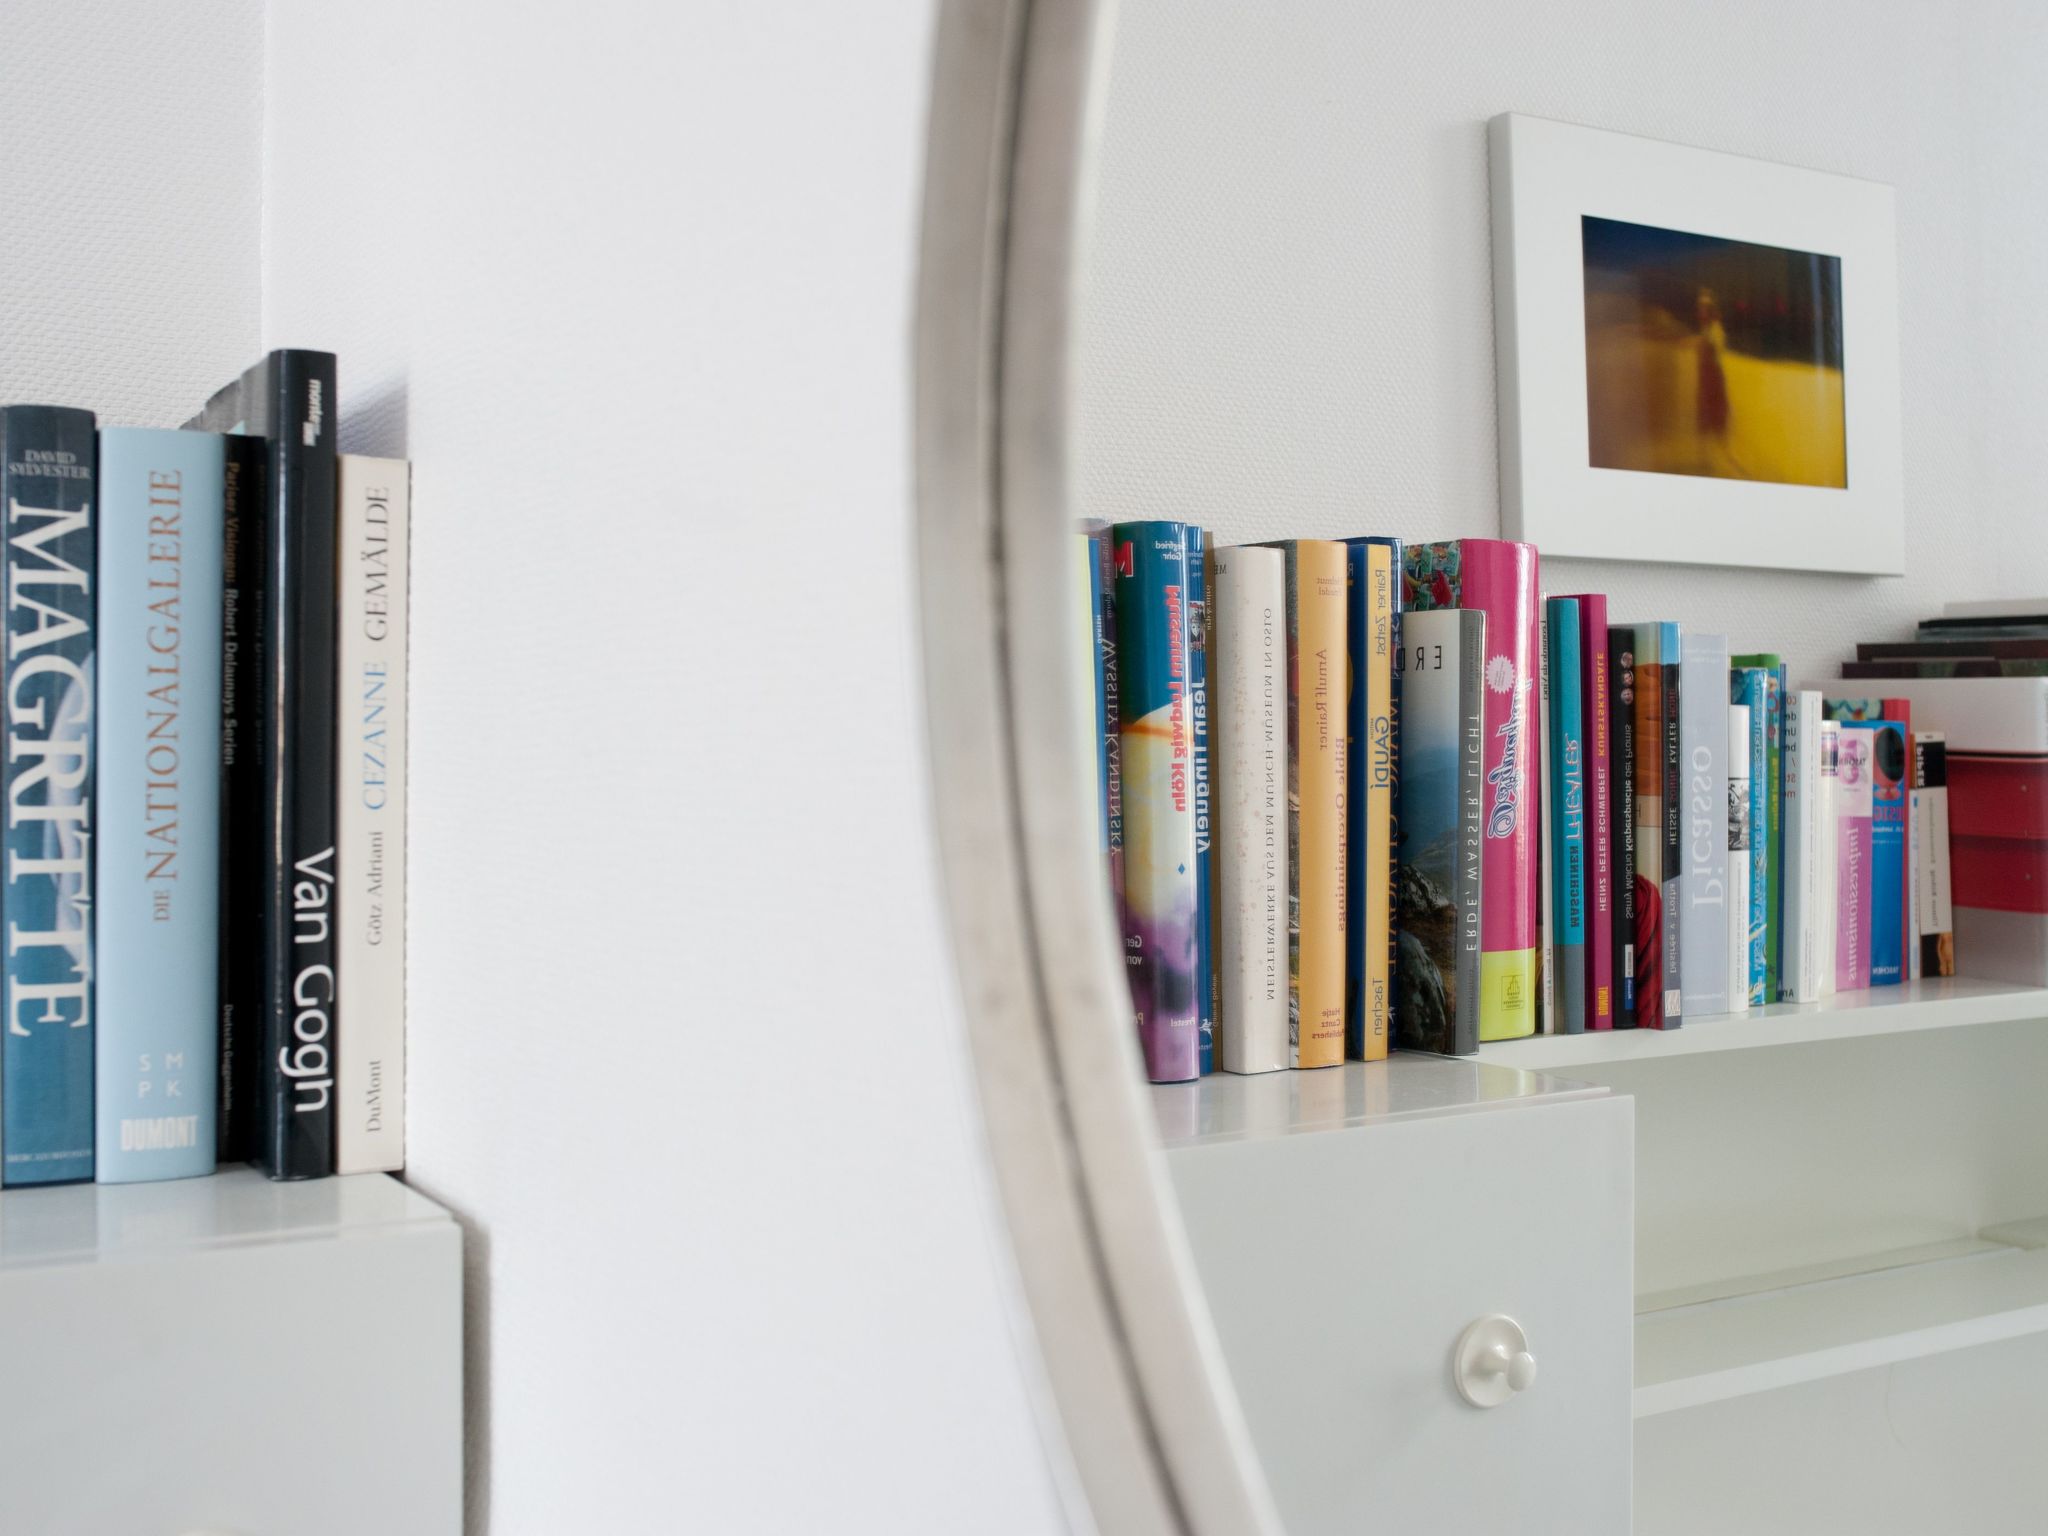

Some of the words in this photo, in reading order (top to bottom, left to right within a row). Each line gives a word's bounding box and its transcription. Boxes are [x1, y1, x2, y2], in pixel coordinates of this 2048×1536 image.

[8, 463, 92, 480] SYLVESTER
[25, 450, 77, 465] DAVID
[361, 486, 390, 641] GEMÄLDE
[224, 588, 239, 637] Robert
[145, 469, 182, 883] NATIONALGALERIE
[224, 642, 238, 714] Delaunays
[8, 497, 91, 1037] MAGRITTE
[223, 719, 237, 765] Serien
[364, 662, 387, 811] CEZANNE
[294, 846, 336, 944] Van
[367, 831, 384, 896] Adriani
[154, 889, 171, 922] DIE
[367, 899, 383, 946] Götz
[279, 964, 335, 1113] Gogh
[366, 1060, 383, 1133] DuMont
[120, 1115, 199, 1152] DUMONT
